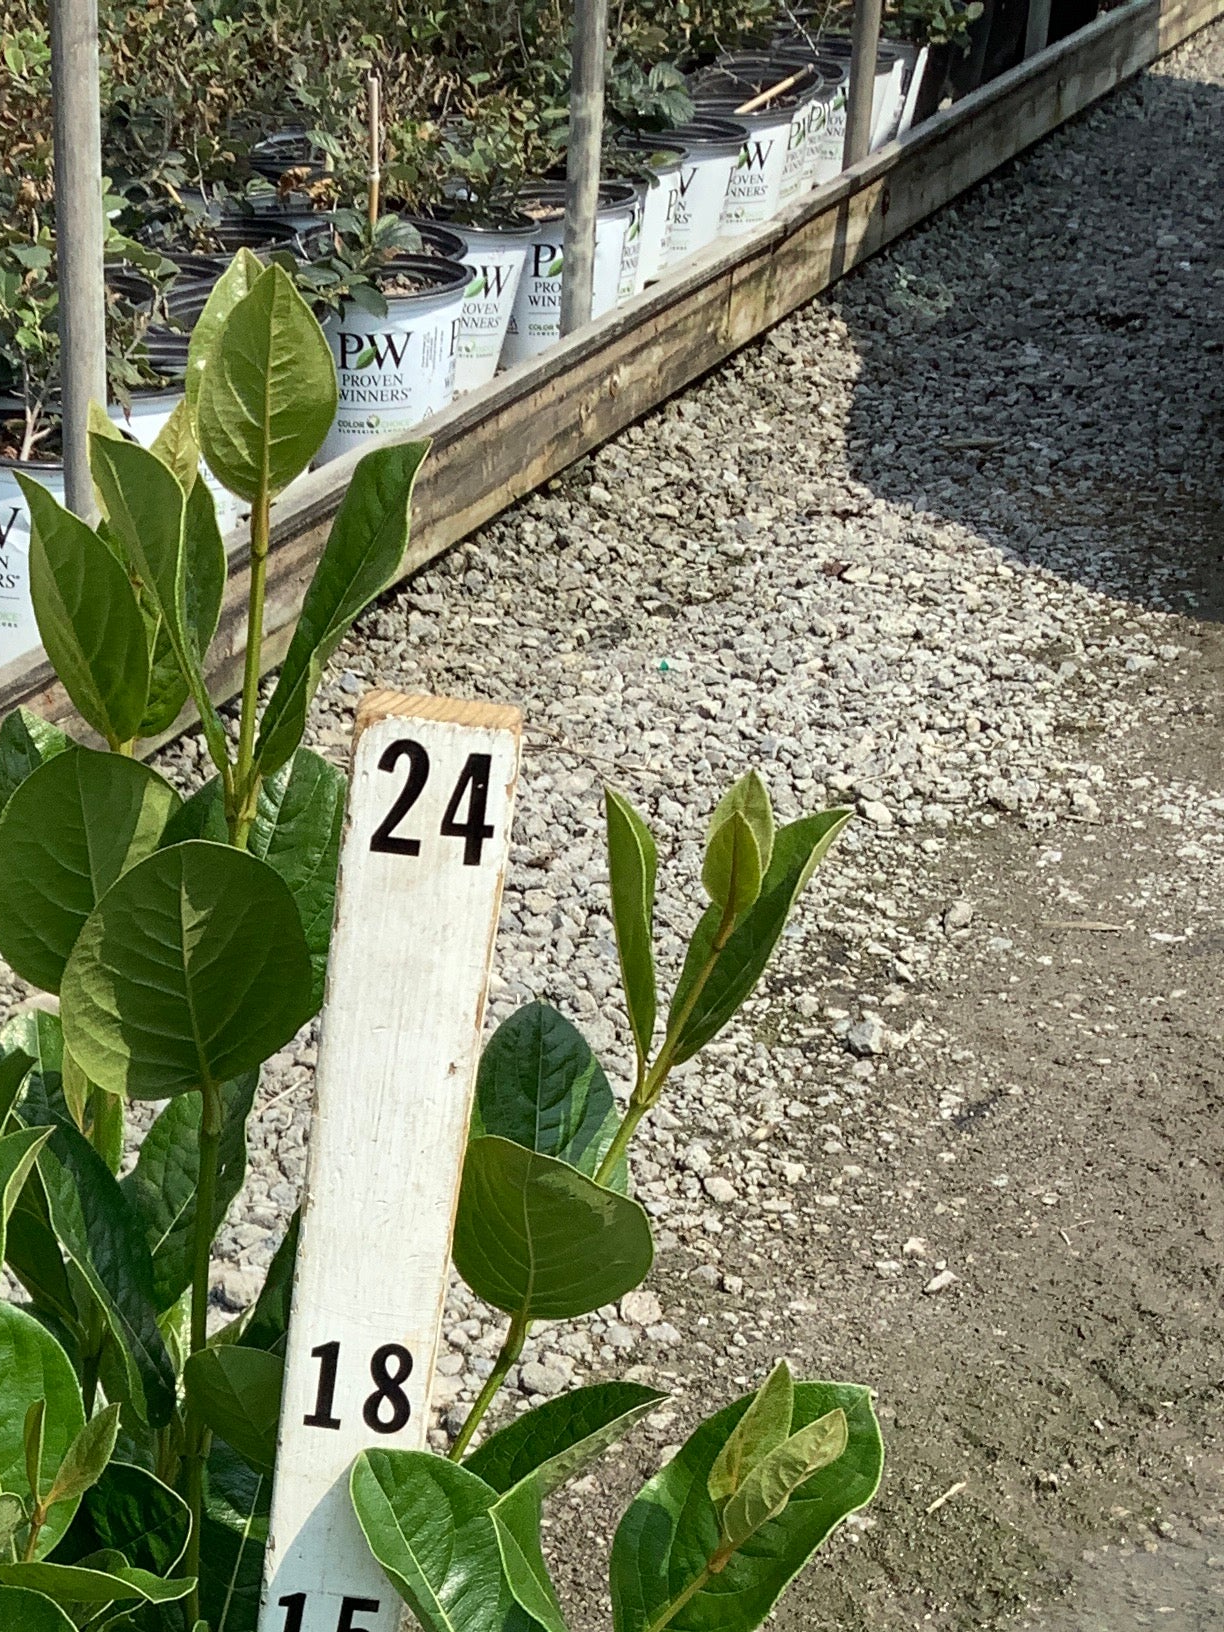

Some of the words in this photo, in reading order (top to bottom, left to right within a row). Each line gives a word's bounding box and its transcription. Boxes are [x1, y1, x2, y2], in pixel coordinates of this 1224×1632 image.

[742, 140, 774, 171] W
[733, 174, 765, 185] OVEN
[730, 186, 766, 198] NNERS
[534, 281, 562, 294] PRO
[462, 302, 501, 315] ROVEN
[461, 316, 502, 330] NNERS
[337, 331, 414, 370] PW
[342, 373, 404, 388] PROVEN
[370, 739, 495, 866] 24
[303, 1341, 413, 1434] 18
